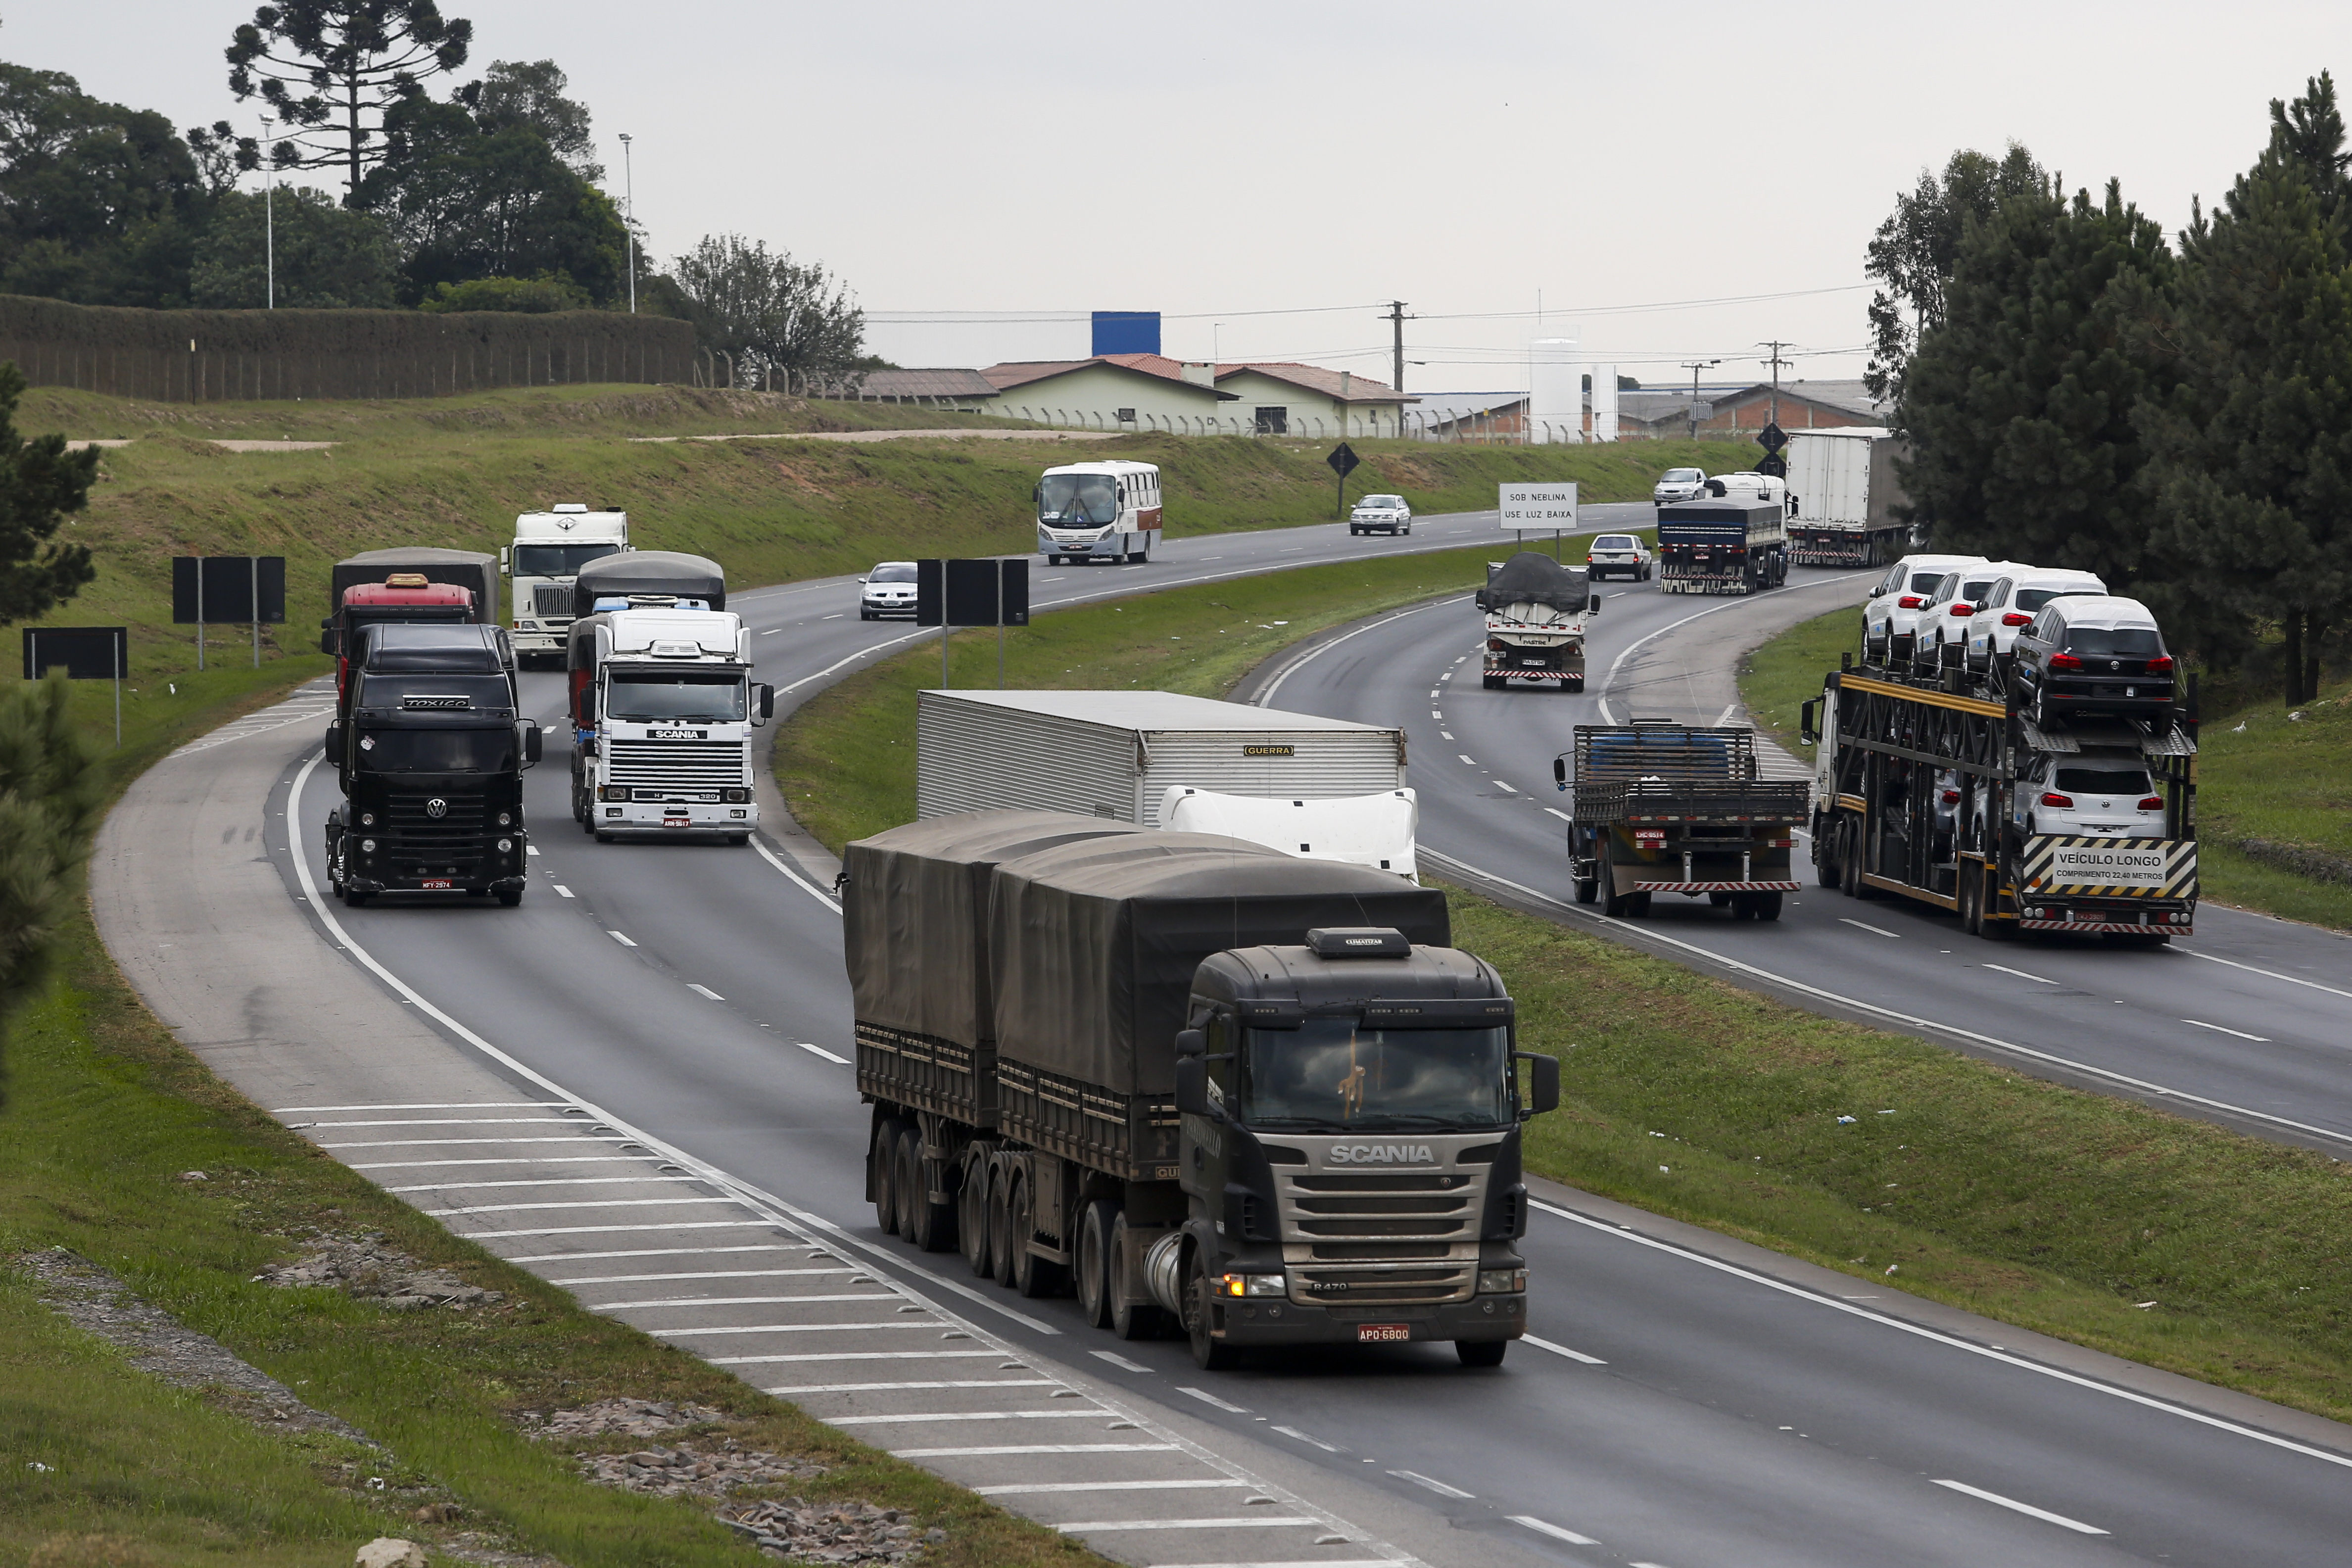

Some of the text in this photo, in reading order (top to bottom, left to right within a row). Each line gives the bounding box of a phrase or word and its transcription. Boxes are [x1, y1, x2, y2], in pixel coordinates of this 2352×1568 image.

[2059, 852, 2161, 866] VEÍCULO LONGO
[1330, 1145, 1435, 1163] SCANIA
